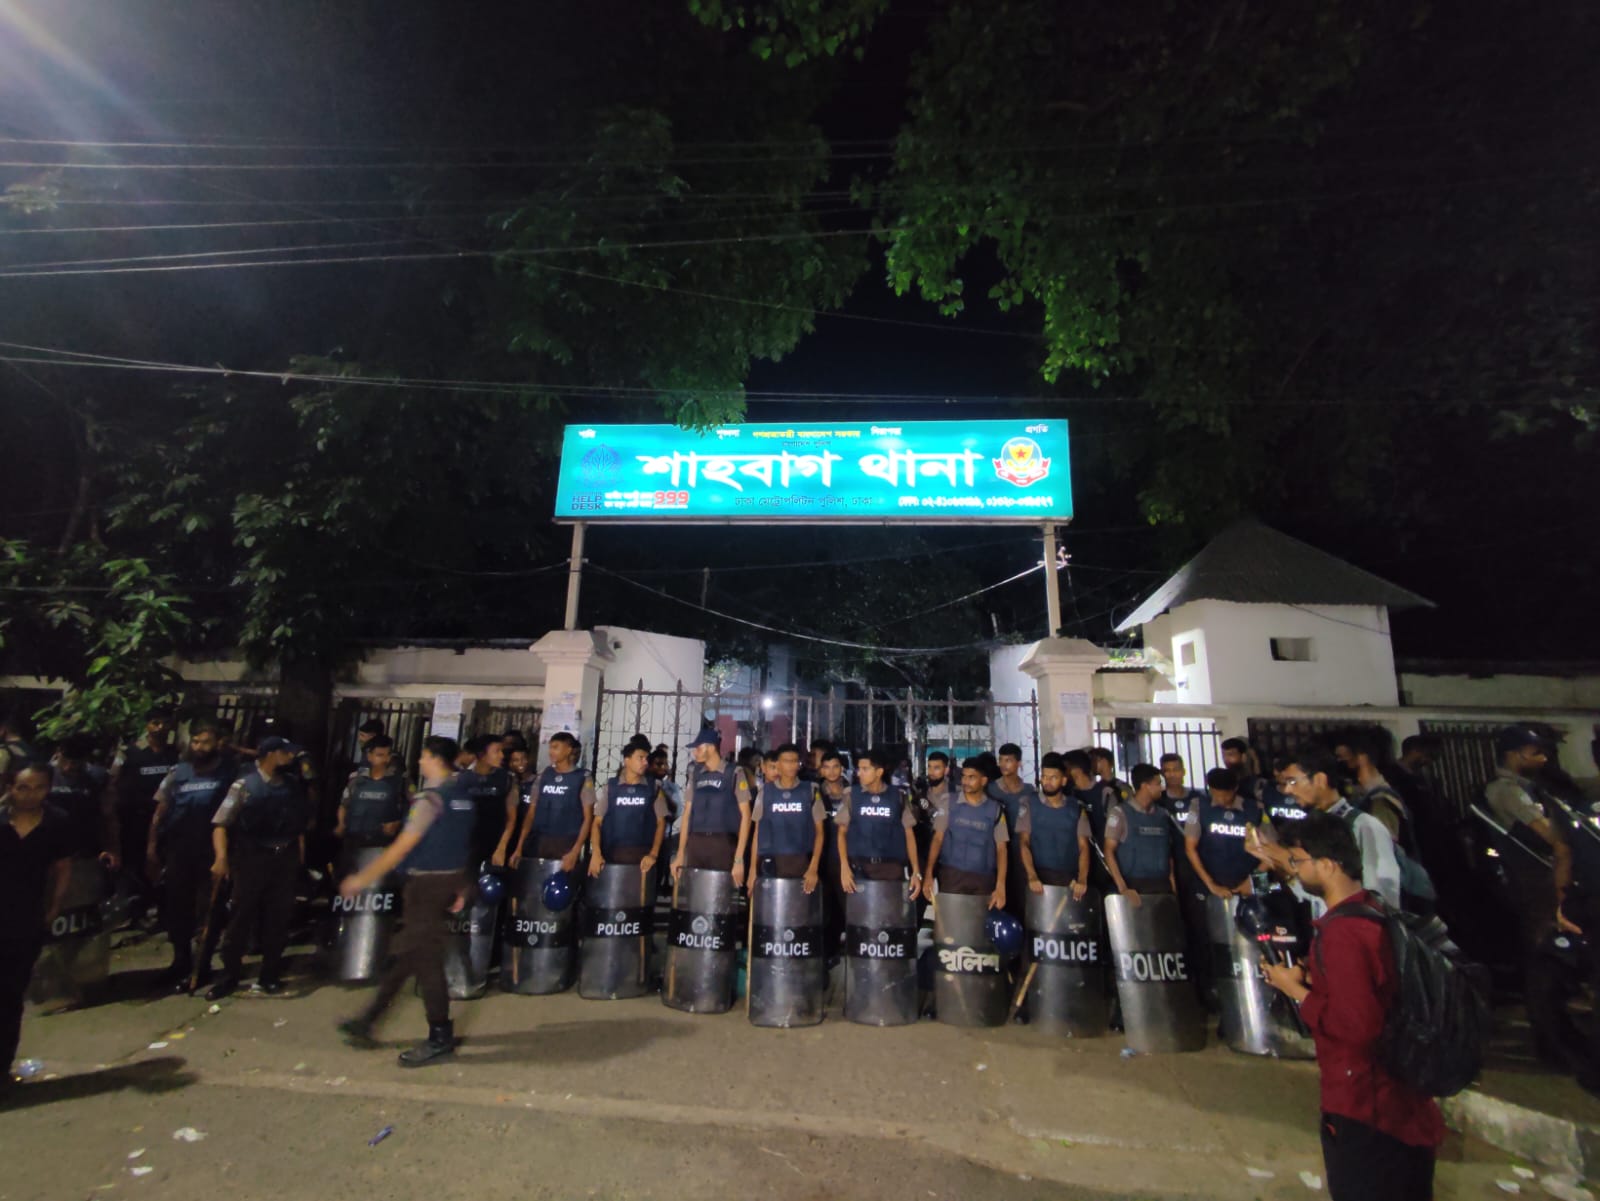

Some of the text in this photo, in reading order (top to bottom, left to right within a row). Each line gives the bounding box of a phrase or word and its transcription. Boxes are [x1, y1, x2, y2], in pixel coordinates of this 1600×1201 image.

[635, 449, 984, 492] শাহবাগ থানা
[572, 495, 602, 503] HELP
[655, 490, 689, 505] 999
[735, 496, 755, 506] ঢাকা
[571, 503, 602, 511] DESK
[615, 797, 644, 806] POLICE
[772, 802, 802, 812] POLICE
[860, 806, 891, 817] POLICE
[1210, 823, 1246, 837] POLICE
[332, 892, 395, 913] POLICE
[515, 919, 557, 934] POLICE
[596, 921, 641, 936] POLICE
[678, 931, 721, 949] POLICE
[765, 941, 809, 957] POLICE
[859, 943, 904, 957] POLICE
[1033, 936, 1099, 962] POLICE
[937, 946, 1000, 974] পুলিশ
[1119, 951, 1188, 982] POLICE
